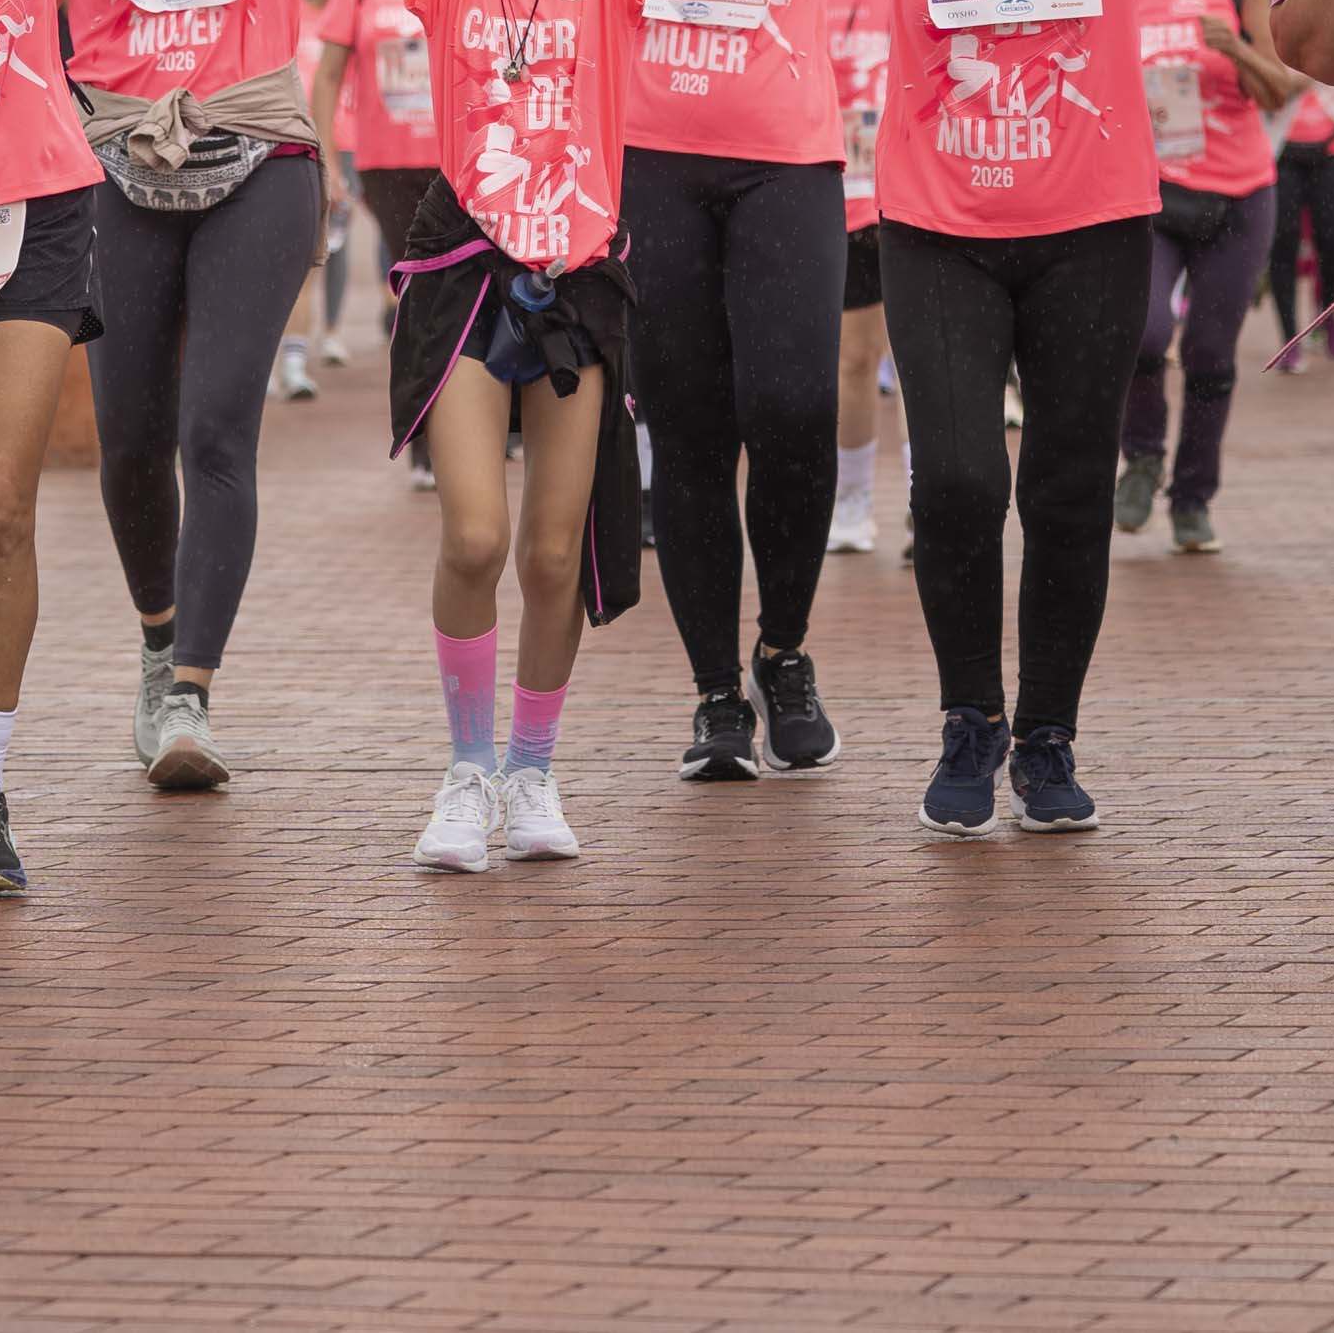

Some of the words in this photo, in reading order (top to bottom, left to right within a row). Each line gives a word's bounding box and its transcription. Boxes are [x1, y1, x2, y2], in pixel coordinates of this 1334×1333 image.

[462, 9, 579, 65] CARRER
[947, 9, 978, 19] OYSHO
[155, 50, 196, 73] 2026
[642, 23, 749, 75] MUJER
[524, 74, 573, 131] DE
[670, 70, 710, 96] 2026
[989, 63, 1028, 116] LA
[936, 115, 1052, 162] MUJER
[515, 161, 552, 215] LA
[970, 165, 1014, 188] 2026
